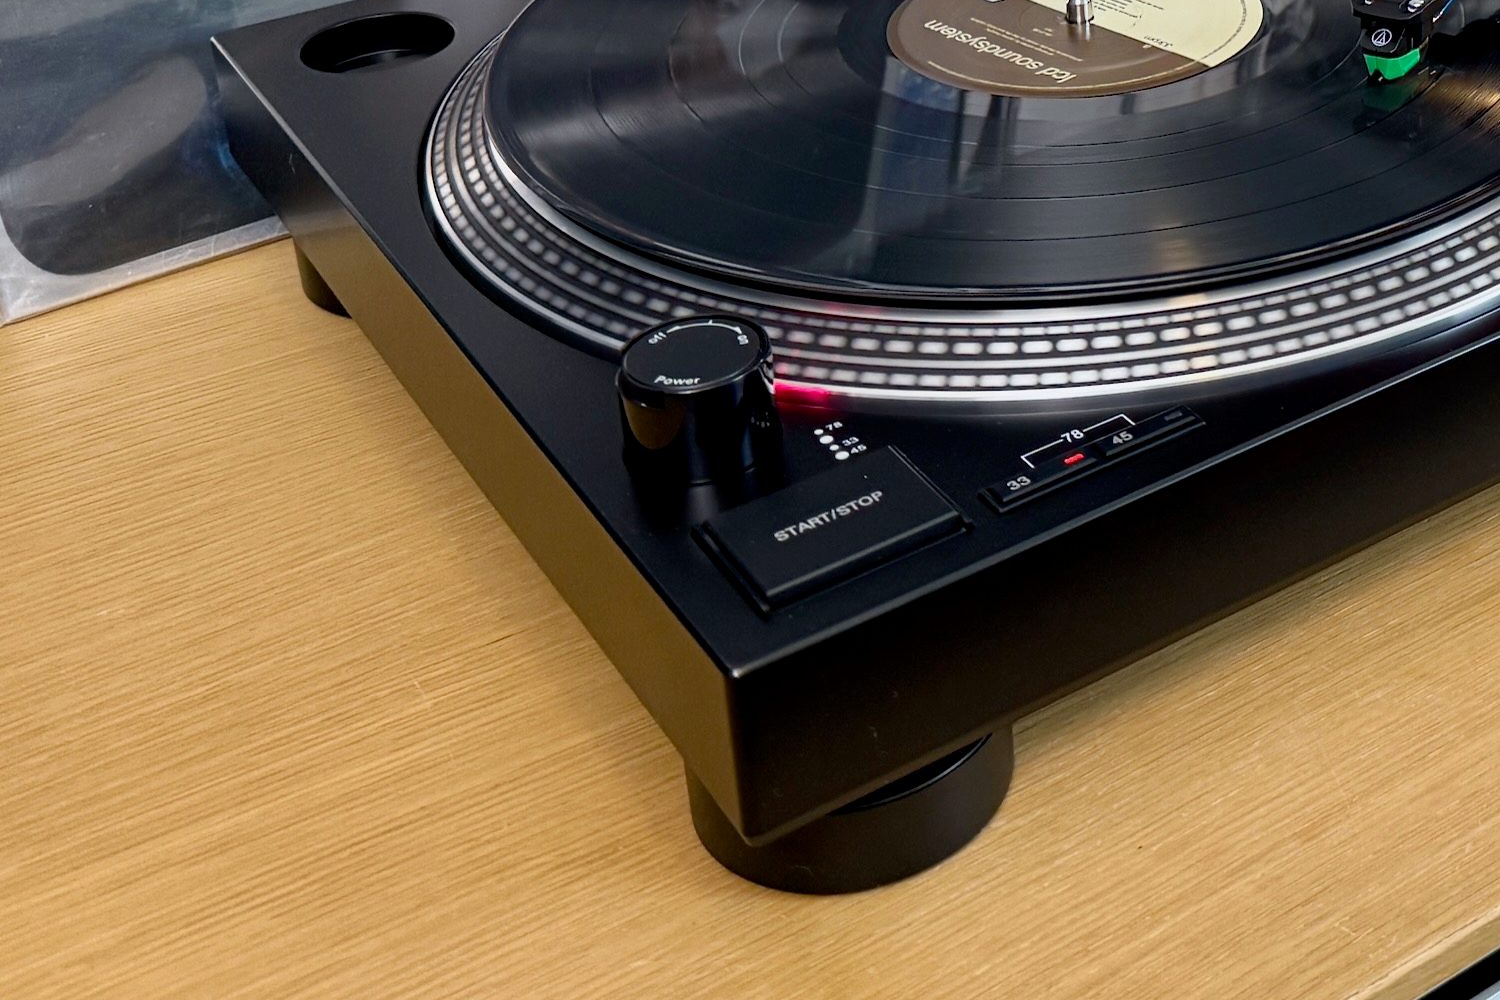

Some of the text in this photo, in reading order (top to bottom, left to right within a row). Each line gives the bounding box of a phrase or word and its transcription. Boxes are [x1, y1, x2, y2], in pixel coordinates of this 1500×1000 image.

[924, 19, 1044, 70] soundsystem
[1034, 66, 1077, 84] lcd
[648, 332, 667, 344] off
[654, 375, 700, 385] Power
[825, 421, 843, 431] 78
[842, 436, 859, 446] 33
[1061, 429, 1084, 443] 78
[1112, 431, 1134, 445] 45
[1006, 475, 1031, 491] 33
[774, 490, 882, 541] START/STOP
